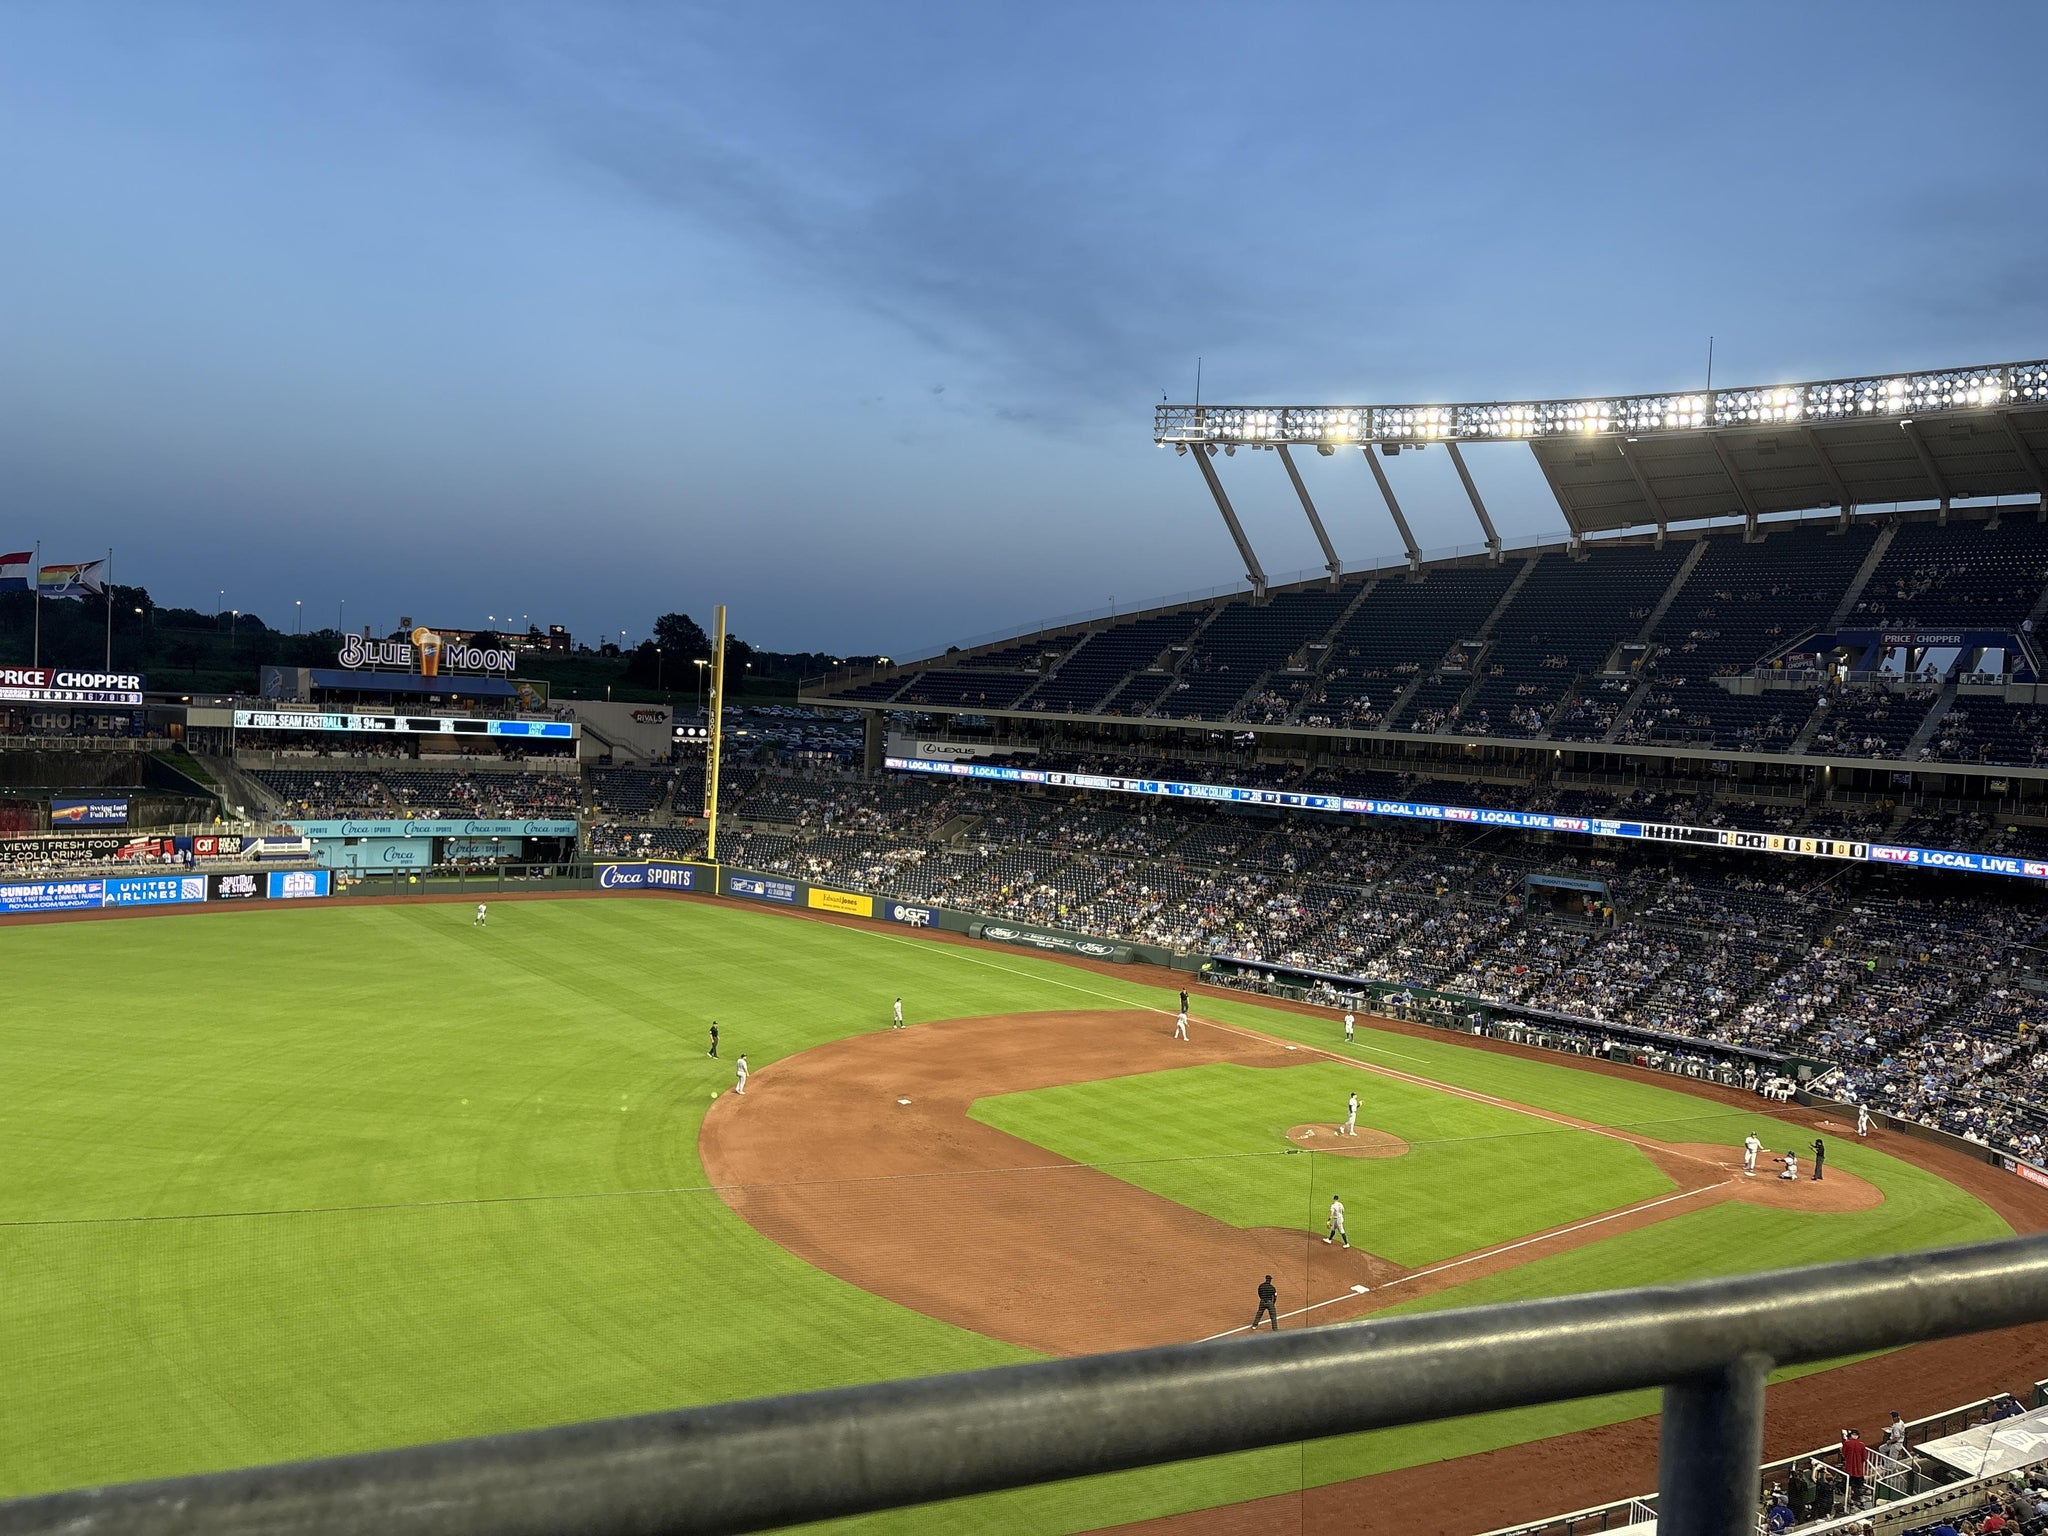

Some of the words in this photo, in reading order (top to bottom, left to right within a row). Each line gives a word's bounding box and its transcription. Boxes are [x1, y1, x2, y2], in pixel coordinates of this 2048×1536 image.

[1884, 635, 1911, 643] PRICE
[1916, 635, 1961, 643] CHOPPER
[56, 673, 140, 689] CHOPPER
[254, 714, 302, 727] FOUR-SEAM
[304, 716, 342, 728] FASTBALL
[363, 717, 374, 729] 94
[637, 714, 663, 722] RIVALS
[937, 746, 975, 755] LEXUS
[1191, 785, 1208, 796] ISAAC
[1209, 786, 1233, 799] COLLINS
[1249, 791, 1262, 801] .215
[1275, 794, 1280, 803] 3
[90, 804, 113, 813] Swing
[1377, 803, 1413, 815] LOCAL.
[1416, 806, 1442, 818] LIVE.
[1481, 812, 1521, 824] LOCAL.
[1523, 815, 1551, 827] LIVE.
[341, 822, 370, 835] Circa
[404, 821, 431, 835] Circa
[464, 821, 492, 835] Circa
[524, 821, 551, 835] Circa
[3, 842, 39, 851] VIEWS
[48, 841, 85, 850] FRESH
[88, 840, 119, 849] FOOD
[196, 839, 214, 852] QT
[447, 839, 479, 857] Circa
[485, 845, 506, 853] SPORTS
[1773, 839, 1779, 848] B
[1788, 839, 1796, 851] 0
[1805, 842, 1811, 851] S
[1822, 842, 1827, 854] 1
[1855, 845, 1863, 857] 0
[52, 850, 93, 859] DRINKS
[383, 846, 415, 862] Circa
[1923, 852, 1978, 868] LOCAL.
[1981, 858, 2020, 873] LIVE.
[600, 865, 643, 889] Circa
[647, 868, 690, 886] SPORTS
[0, 885, 45, 897] SUNDAY
[46, 883, 87, 895] 4-PACK
[120, 881, 177, 892] UNITED
[218, 884, 231, 894] THE
[231, 883, 257, 893] STIGMA
[106, 890, 177, 902] AIRLINES
[9, 900, 89, 909] ROYALS.COM/SUNDAY
[990, 927, 1014, 938] Ford
[1081, 942, 1105, 954] Ford
